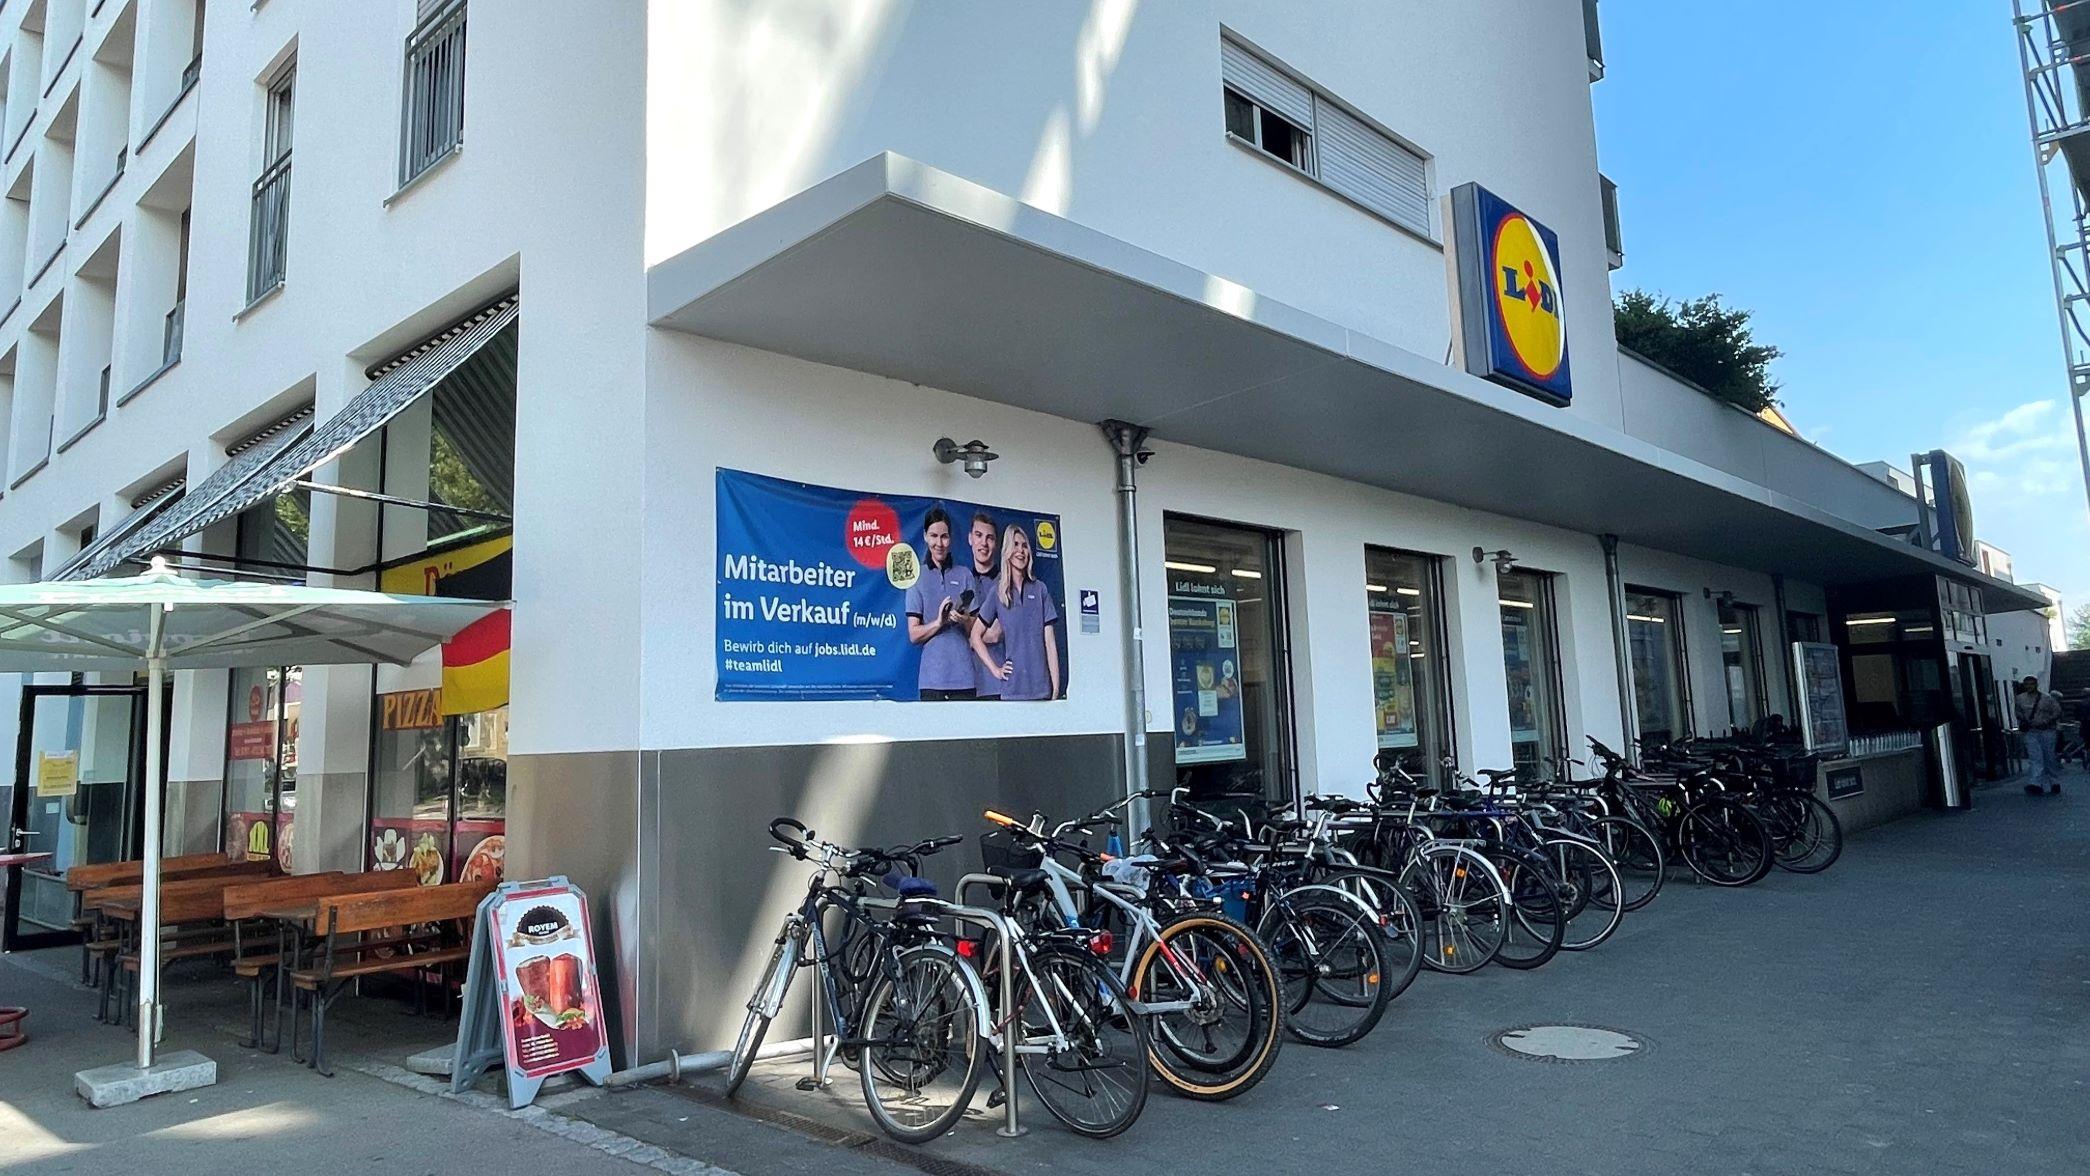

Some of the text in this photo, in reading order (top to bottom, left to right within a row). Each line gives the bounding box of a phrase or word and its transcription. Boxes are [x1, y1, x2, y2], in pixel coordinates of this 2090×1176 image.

[853, 519, 880, 532] Mind.
[724, 553, 856, 588] Mitarbeiter
[723, 592, 897, 628] im Verkauf (m/w/d)
[723, 639, 876, 657] Bewirb dich auf jobs.lidl.de
[724, 658, 783, 673] #teamlidl
[384, 690, 442, 728] PIZZA
[528, 922, 559, 934] ROYEM
